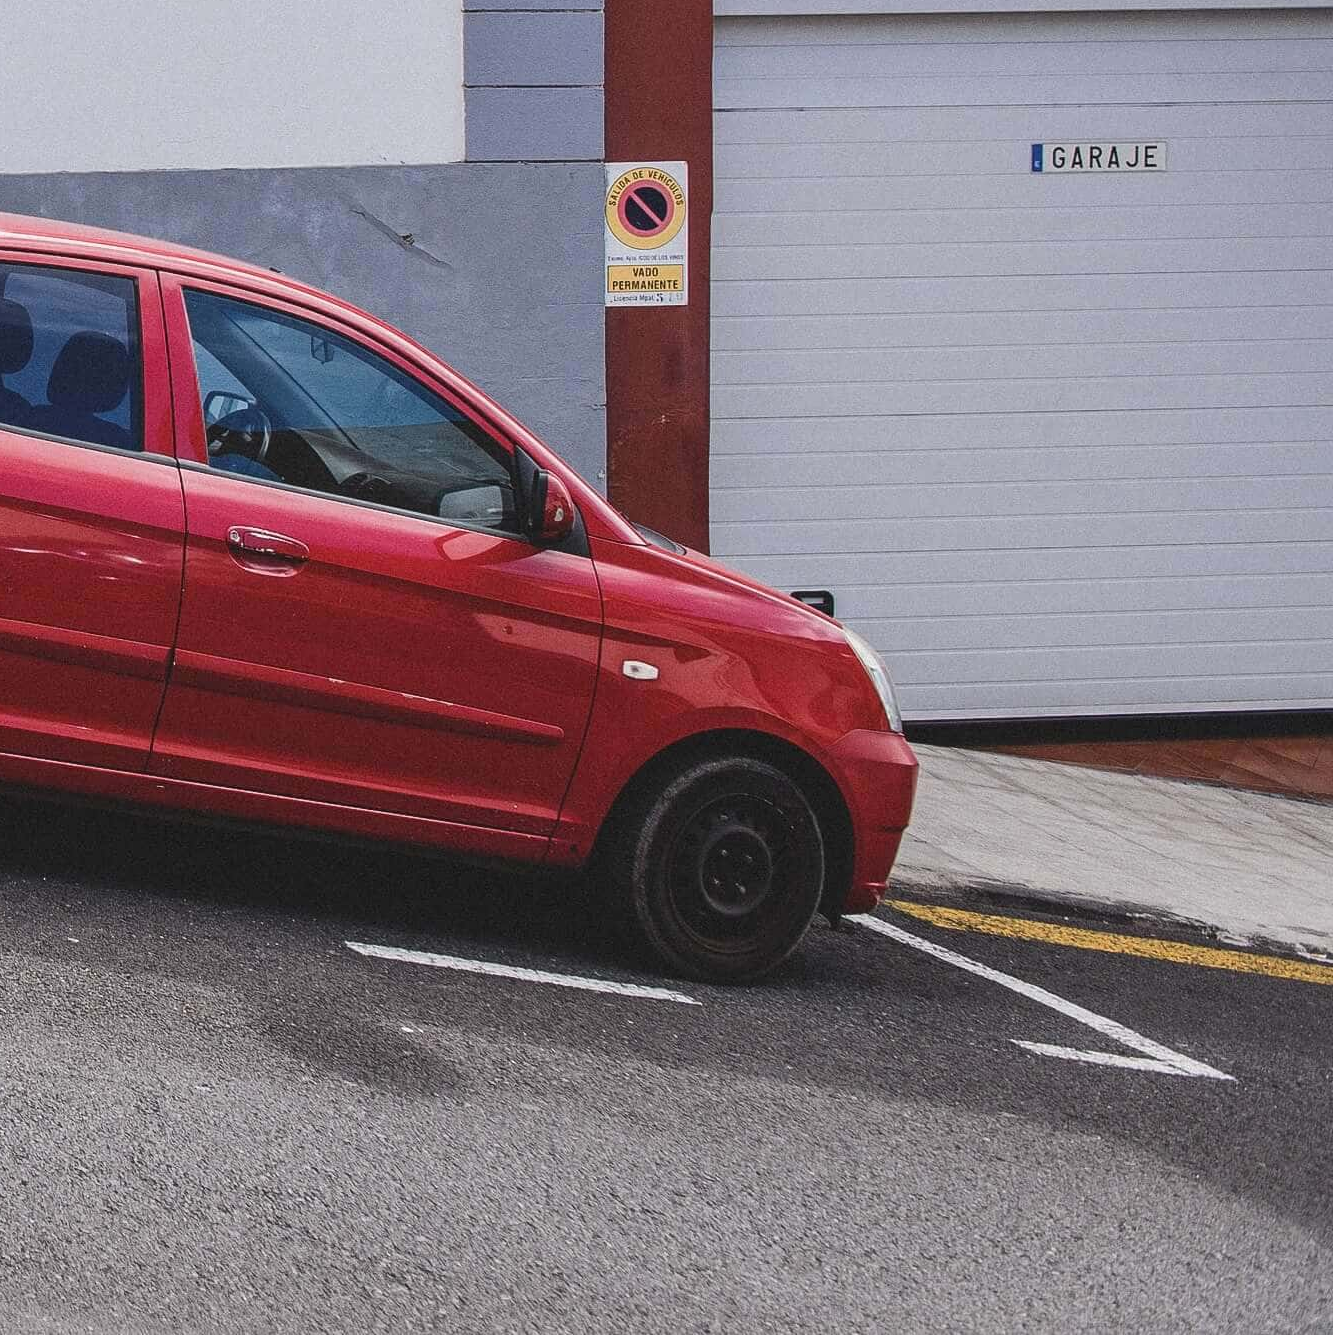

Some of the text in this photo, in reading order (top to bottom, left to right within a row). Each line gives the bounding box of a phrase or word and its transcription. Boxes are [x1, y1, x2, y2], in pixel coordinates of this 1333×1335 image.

[1052, 146, 1158, 169] GARAJE
[608, 170, 684, 206] SALIDA DE VEHICULOS
[633, 267, 659, 277] VADO
[612, 280, 679, 291] PERMANENTE
